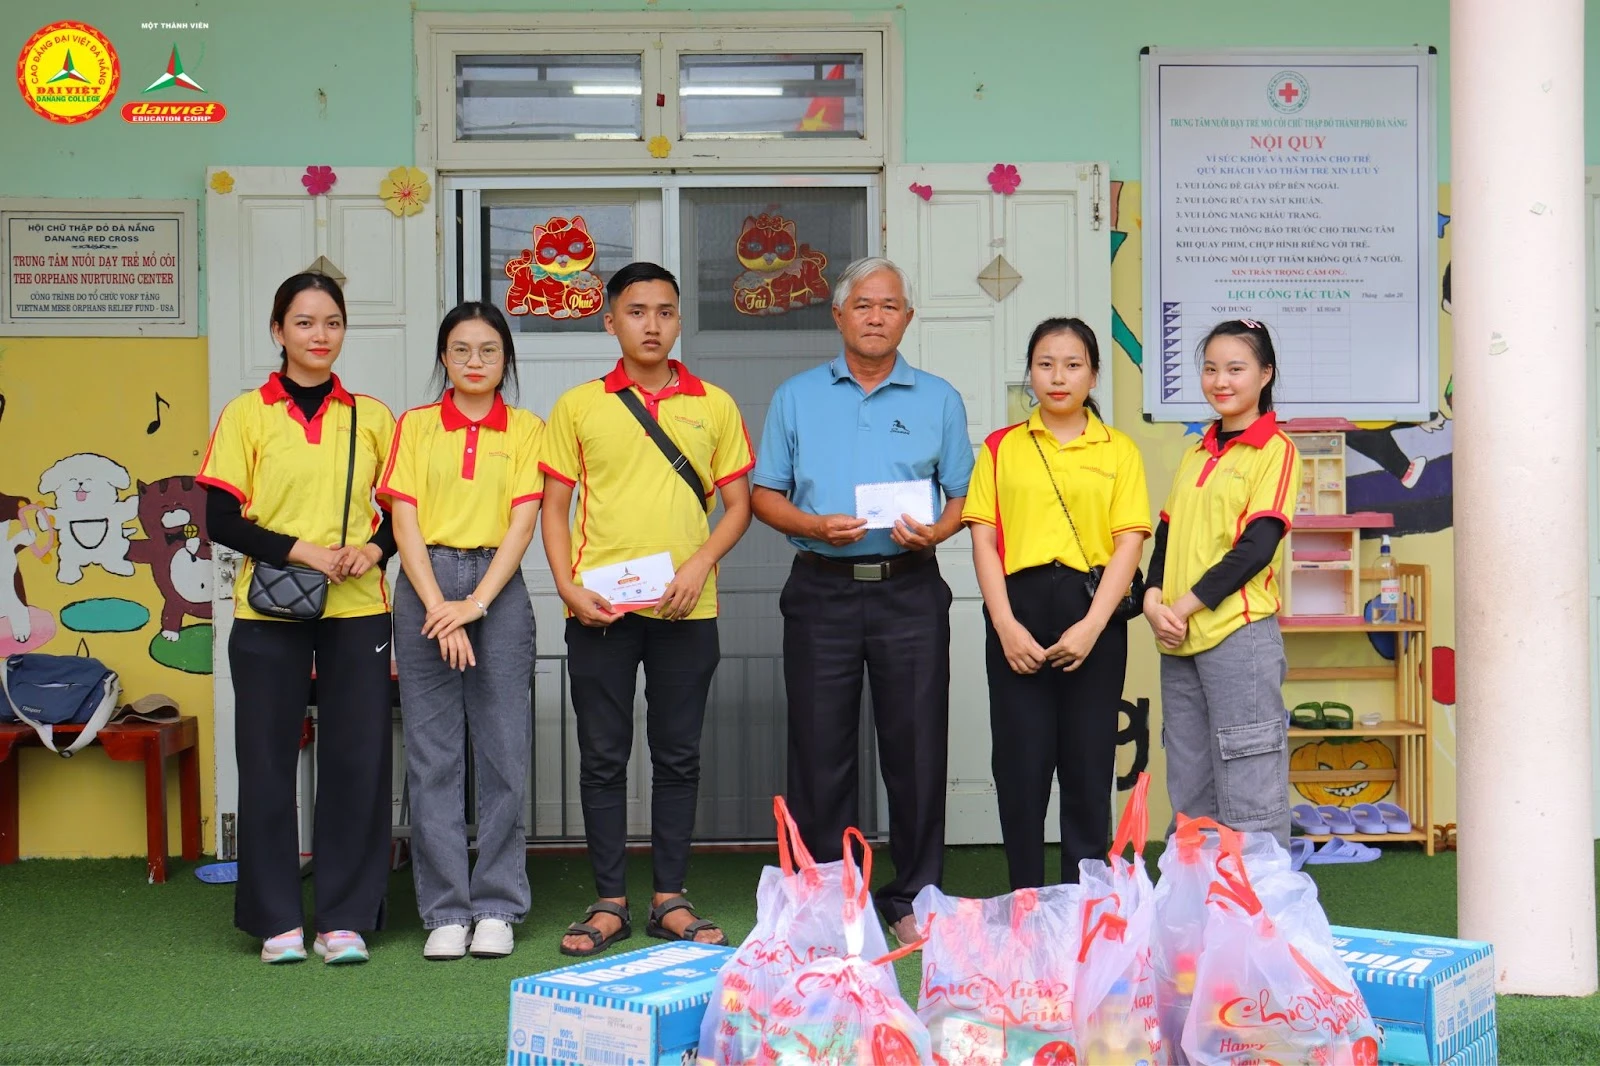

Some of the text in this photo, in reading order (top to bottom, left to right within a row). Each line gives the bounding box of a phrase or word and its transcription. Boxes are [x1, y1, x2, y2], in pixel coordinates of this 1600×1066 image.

[1170, 118, 1193, 128] TRUNG
[1250, 134, 1326, 152] NỘI QUY
[1270, 154, 1284, 163] VÀ
[1286, 154, 1298, 163] AN
[1300, 154, 1326, 163] TOÀN
[1329, 154, 1350, 163] CHO
[1220, 166, 1254, 175] KHÁCH
[1256, 166, 1277, 175] VÀO
[1332, 166, 1348, 175] XIN
[1176, 196, 1182, 204] 2.
[1184, 196, 1200, 204] VUI
[1202, 196, 1227, 204] LÒNG
[1251, 196, 1267, 204] TAY
[28, 224, 44, 232] HỘI
[1176, 225, 1182, 233] 4.
[1184, 225, 1200, 233] VUI
[1202, 225, 1227, 233] LÒNG
[1230, 225, 1262, 233] THÔNG
[1264, 225, 1283, 233] BÁO
[1319, 225, 1339, 233] CHO
[1342, 225, 1372, 233] TRUNG
[1374, 225, 1395, 233] TÂM
[13, 256, 45, 266] TRUNG
[1176, 255, 1182, 263] 5.
[1184, 255, 1200, 263] VUI
[1202, 255, 1227, 263] LÒNG
[1307, 255, 1340, 263] KHÔNG
[1364, 255, 1368, 263] 7
[1232, 268, 1246, 276] XIN
[14, 273, 174, 284] THE ORPHANS NURTURING CENTER
[30, 291, 50, 300] CÔNG
[1228, 290, 1255, 300] LỊCH
[1258, 288, 1291, 299] CÔNG
[1294, 288, 1316, 298] TÁC
[16, 304, 50, 312] VIETNAM
[72, 304, 106, 312] ORPHANS
[108, 304, 133, 312] RELIEF
[135, 304, 155, 312] FUND
[160, 304, 174, 312] USA
